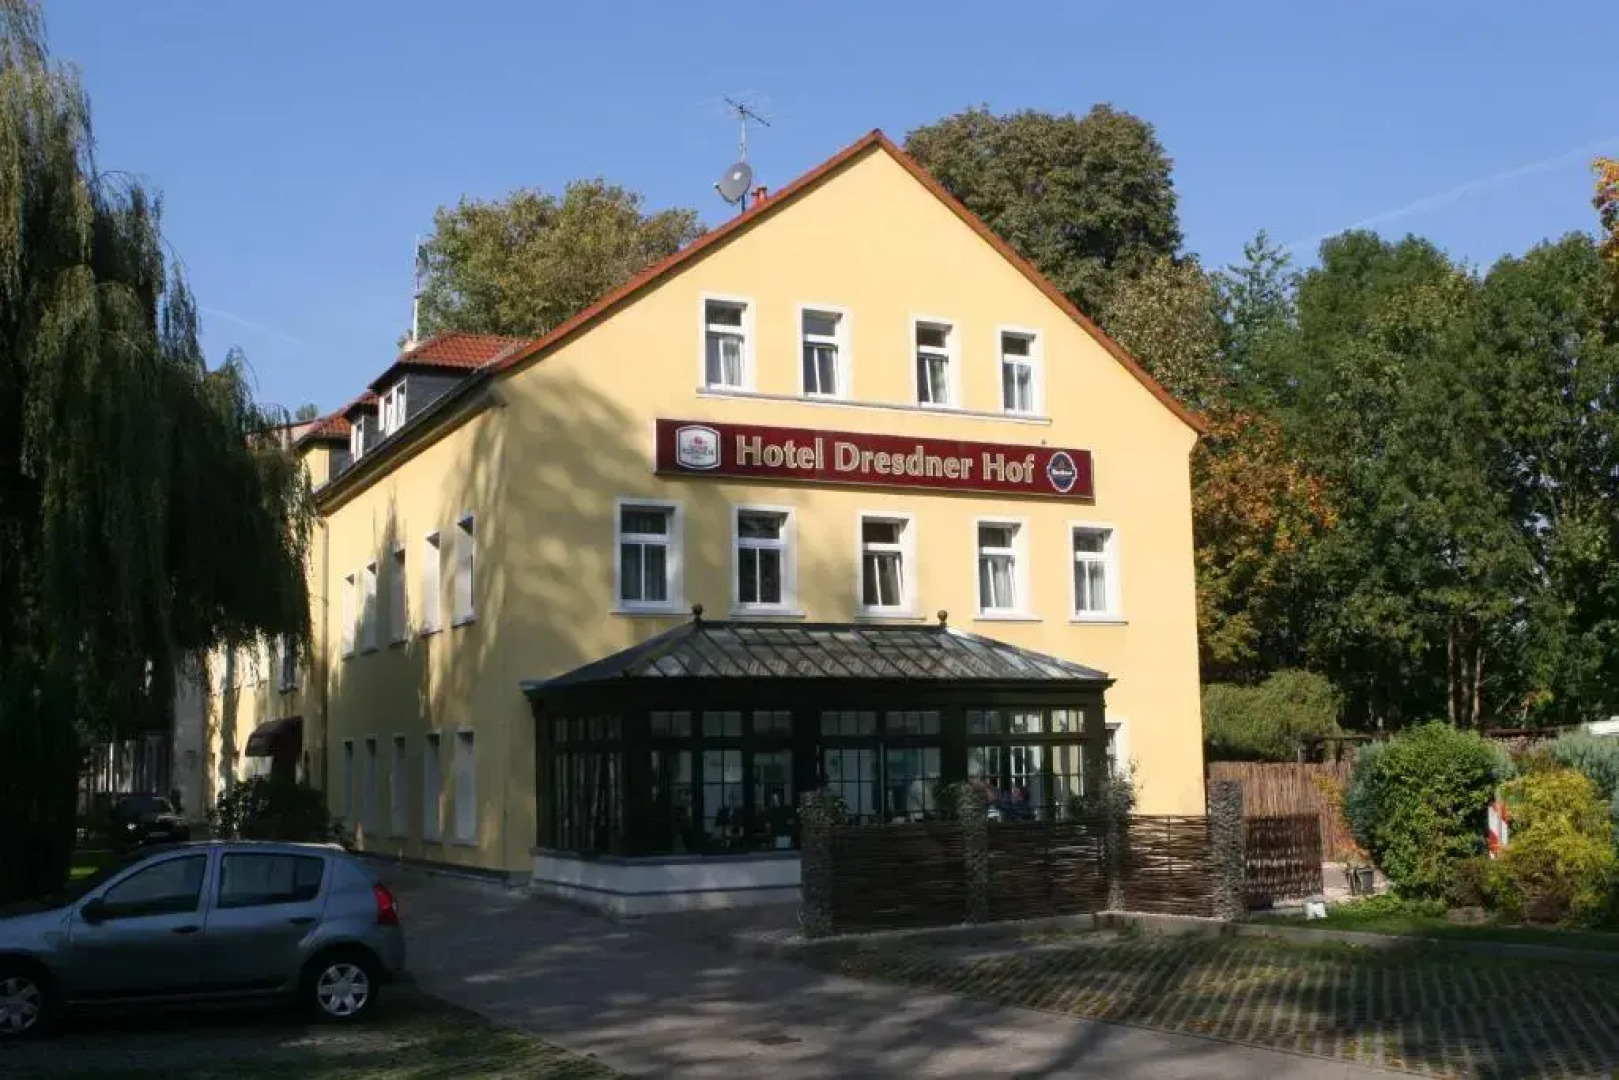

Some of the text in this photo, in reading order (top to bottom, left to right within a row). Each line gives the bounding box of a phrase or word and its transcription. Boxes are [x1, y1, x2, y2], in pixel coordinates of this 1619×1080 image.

[735, 434, 1035, 484] Hotel Dresdner Hof
